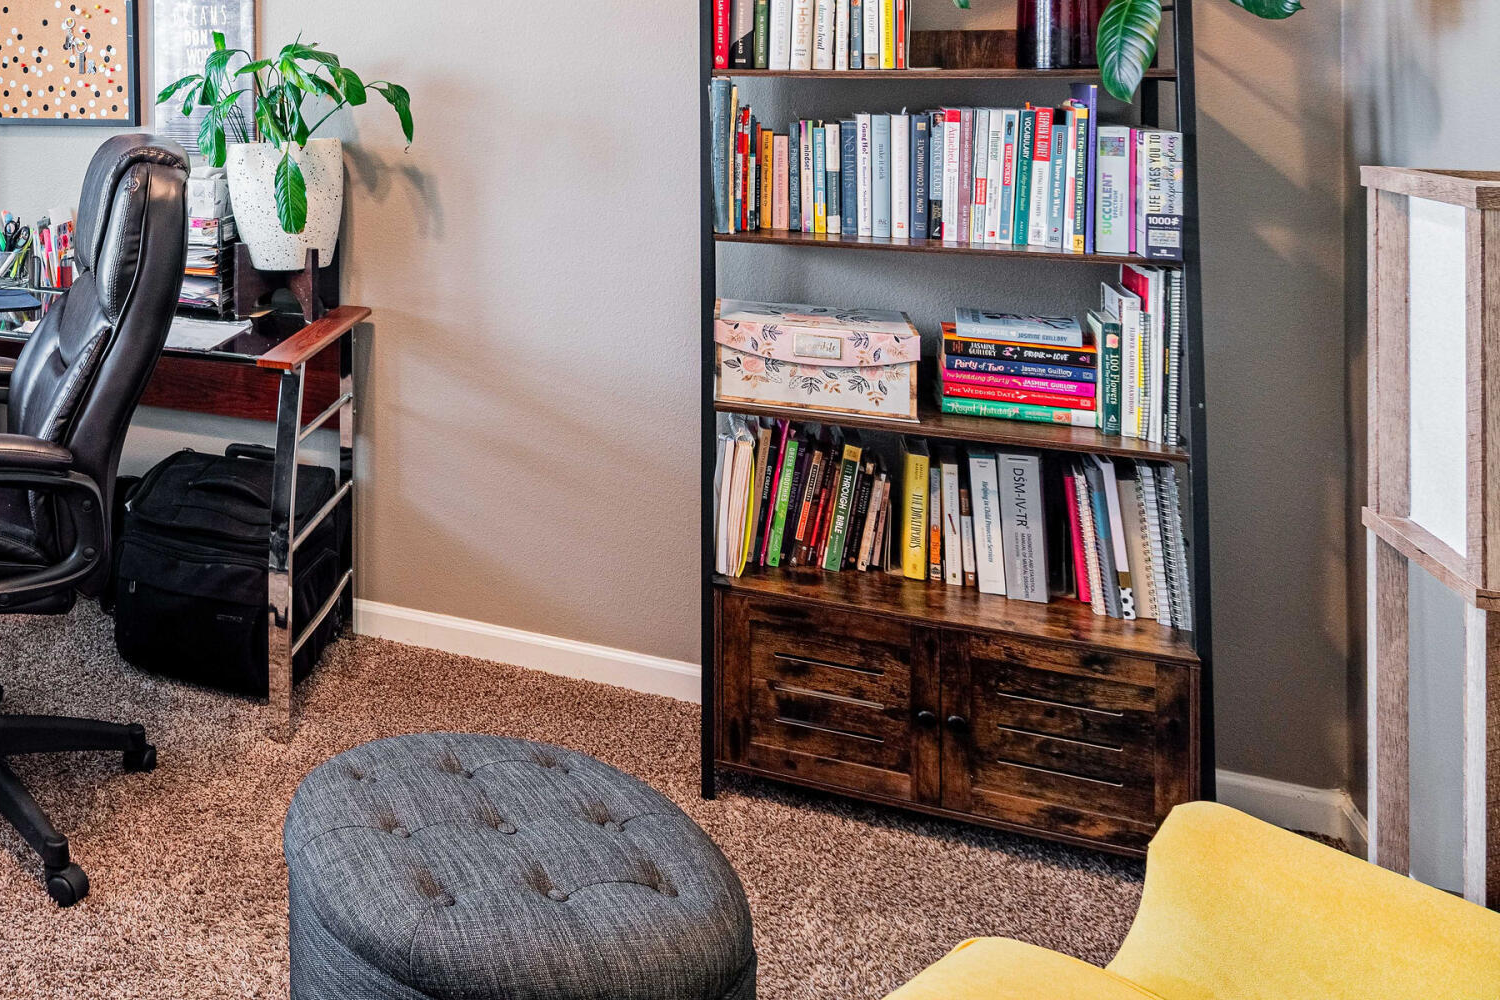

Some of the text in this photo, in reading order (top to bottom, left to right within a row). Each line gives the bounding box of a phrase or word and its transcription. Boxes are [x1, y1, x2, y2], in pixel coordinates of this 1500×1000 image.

[796, 7, 808, 45] Habits
[1038, 112, 1049, 135] STEPHEN
[990, 130, 1000, 161] Influencer
[1022, 116, 1031, 159] VOCABULARY
[1036, 141, 1047, 158] COVEY
[844, 135, 854, 188] NO LIMITS
[1004, 144, 1012, 185] WELL-SPOKEN
[1054, 159, 1062, 180] Where
[1149, 134, 1161, 212] LIFE TAKES YOU TO
[917, 188, 925, 196] TO
[1054, 188, 1061, 197] Go
[916, 198, 924, 213] HOW
[1102, 172, 1112, 235] SUCCULENT
[1148, 216, 1172, 225] 1000
[968, 348, 996, 356] GUILLORY
[970, 342, 995, 350] JASMINE
[1023, 350, 1046, 359] DRUNK
[954, 359, 978, 370] Party
[988, 363, 1004, 371] Two
[1021, 365, 1072, 377] Jasmine Guillory
[955, 373, 1010, 385] Wedding Party
[1110, 354, 1120, 405] 100 Flowers
[962, 387, 996, 396] WEDDING
[947, 402, 976, 413] Royal
[781, 447, 796, 502] GREEN SMOOTHIES
[762, 476, 771, 500] CREATIVE
[834, 475, 852, 534] THROUGH BIBLE
[909, 494, 924, 549] THE DAVENPORTS
